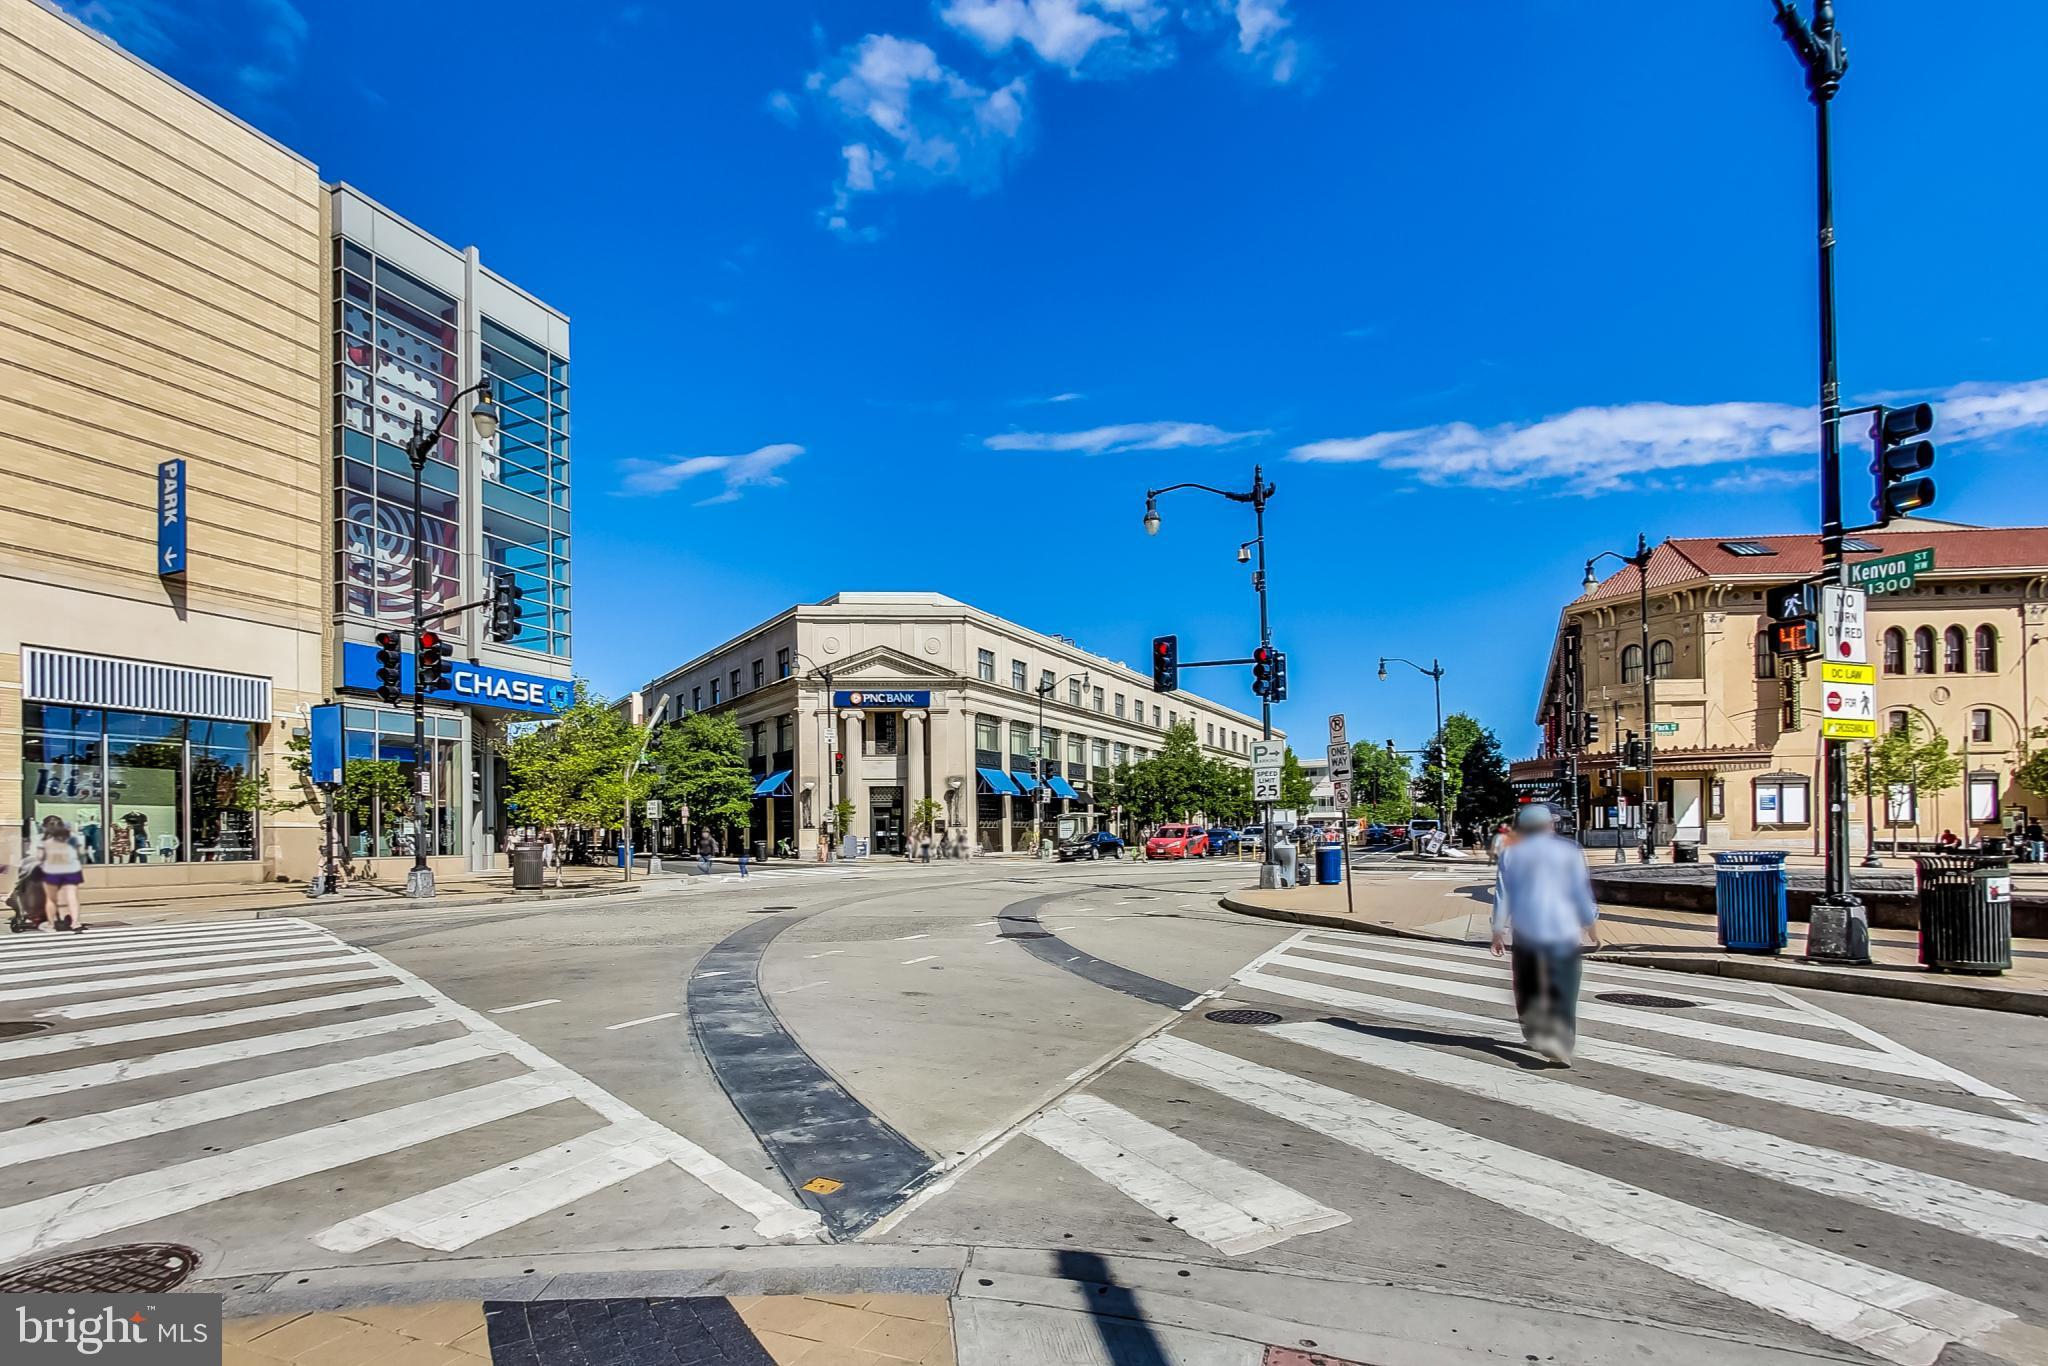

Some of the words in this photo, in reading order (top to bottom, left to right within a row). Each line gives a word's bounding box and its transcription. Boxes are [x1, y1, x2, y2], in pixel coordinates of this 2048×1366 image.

[164, 462, 178, 527] PARK
[1852, 560, 1906, 582] Kenyon
[1914, 551, 1929, 561] ST
[1914, 561, 1929, 571] NW
[1868, 577, 1911, 595] 1300
[1836, 593, 1855, 608] NO
[1844, 627, 1863, 639] RED
[1831, 668, 1843, 678] DC
[1845, 669, 1863, 679] LAW
[455, 671, 545, 704] CHASE
[863, 693, 886, 703] PNC
[886, 692, 915, 703] BANK
[1654, 723, 1670, 732] Park
[1331, 746, 1347, 757] ONE
[1331, 756, 1348, 767] WAY
[1257, 785, 1278, 797] 25
